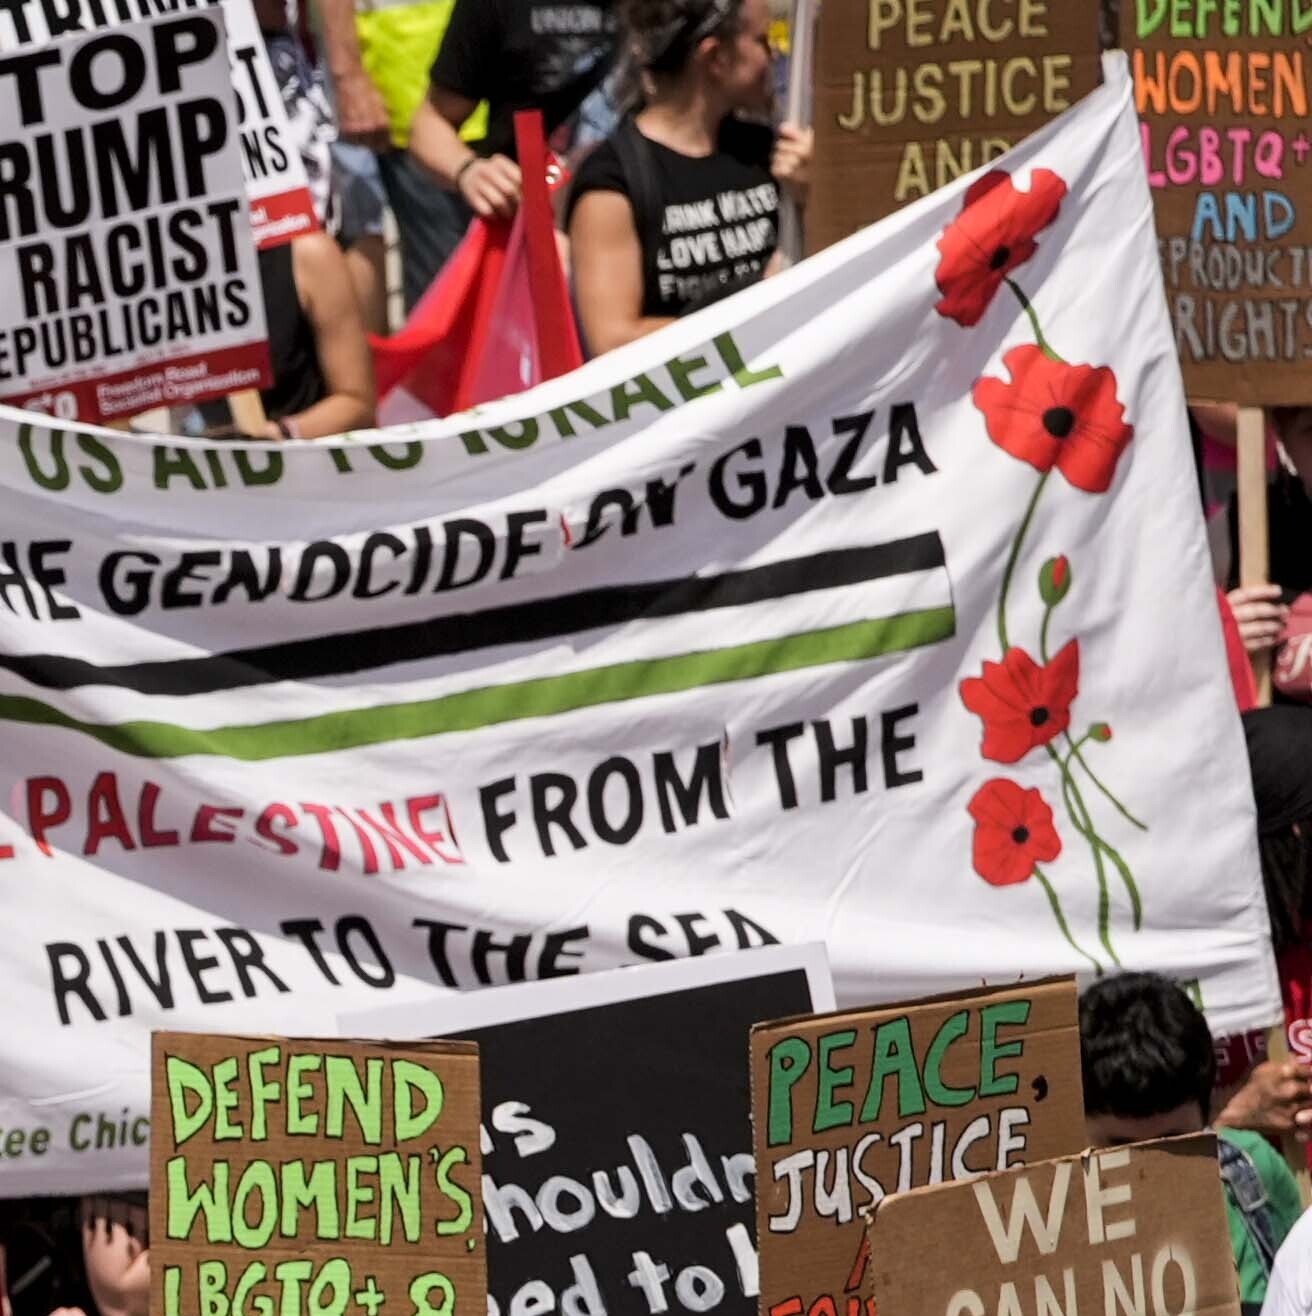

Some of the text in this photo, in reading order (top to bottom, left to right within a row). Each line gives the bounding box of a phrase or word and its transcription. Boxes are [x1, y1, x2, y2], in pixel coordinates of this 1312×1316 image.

[867, 0, 1049, 49] PEACE
[838, 54, 1073, 130] JUSTICE
[16, 199, 241, 321] RACIST
[1191, 191, 1296, 242] AND
[16, 423, 125, 495] US
[97, 508, 549, 618] GENOCIDE
[707, 400, 939, 523] GAZA
[26, 770, 465, 876] PALESTINE
[477, 740, 731, 865] FROM
[754, 702, 924, 811] THE
[45, 926, 290, 1026] RIVER
[280, 913, 397, 990] TO
[411, 917, 591, 992] THE
[164, 1044, 445, 1150] DEFEND
[765, 998, 1050, 1147] PEACE,
[768, 1106, 1032, 1235] JUSTICE
[972, 1148, 1139, 1267] WE
[627, 1249, 726, 1314] to
